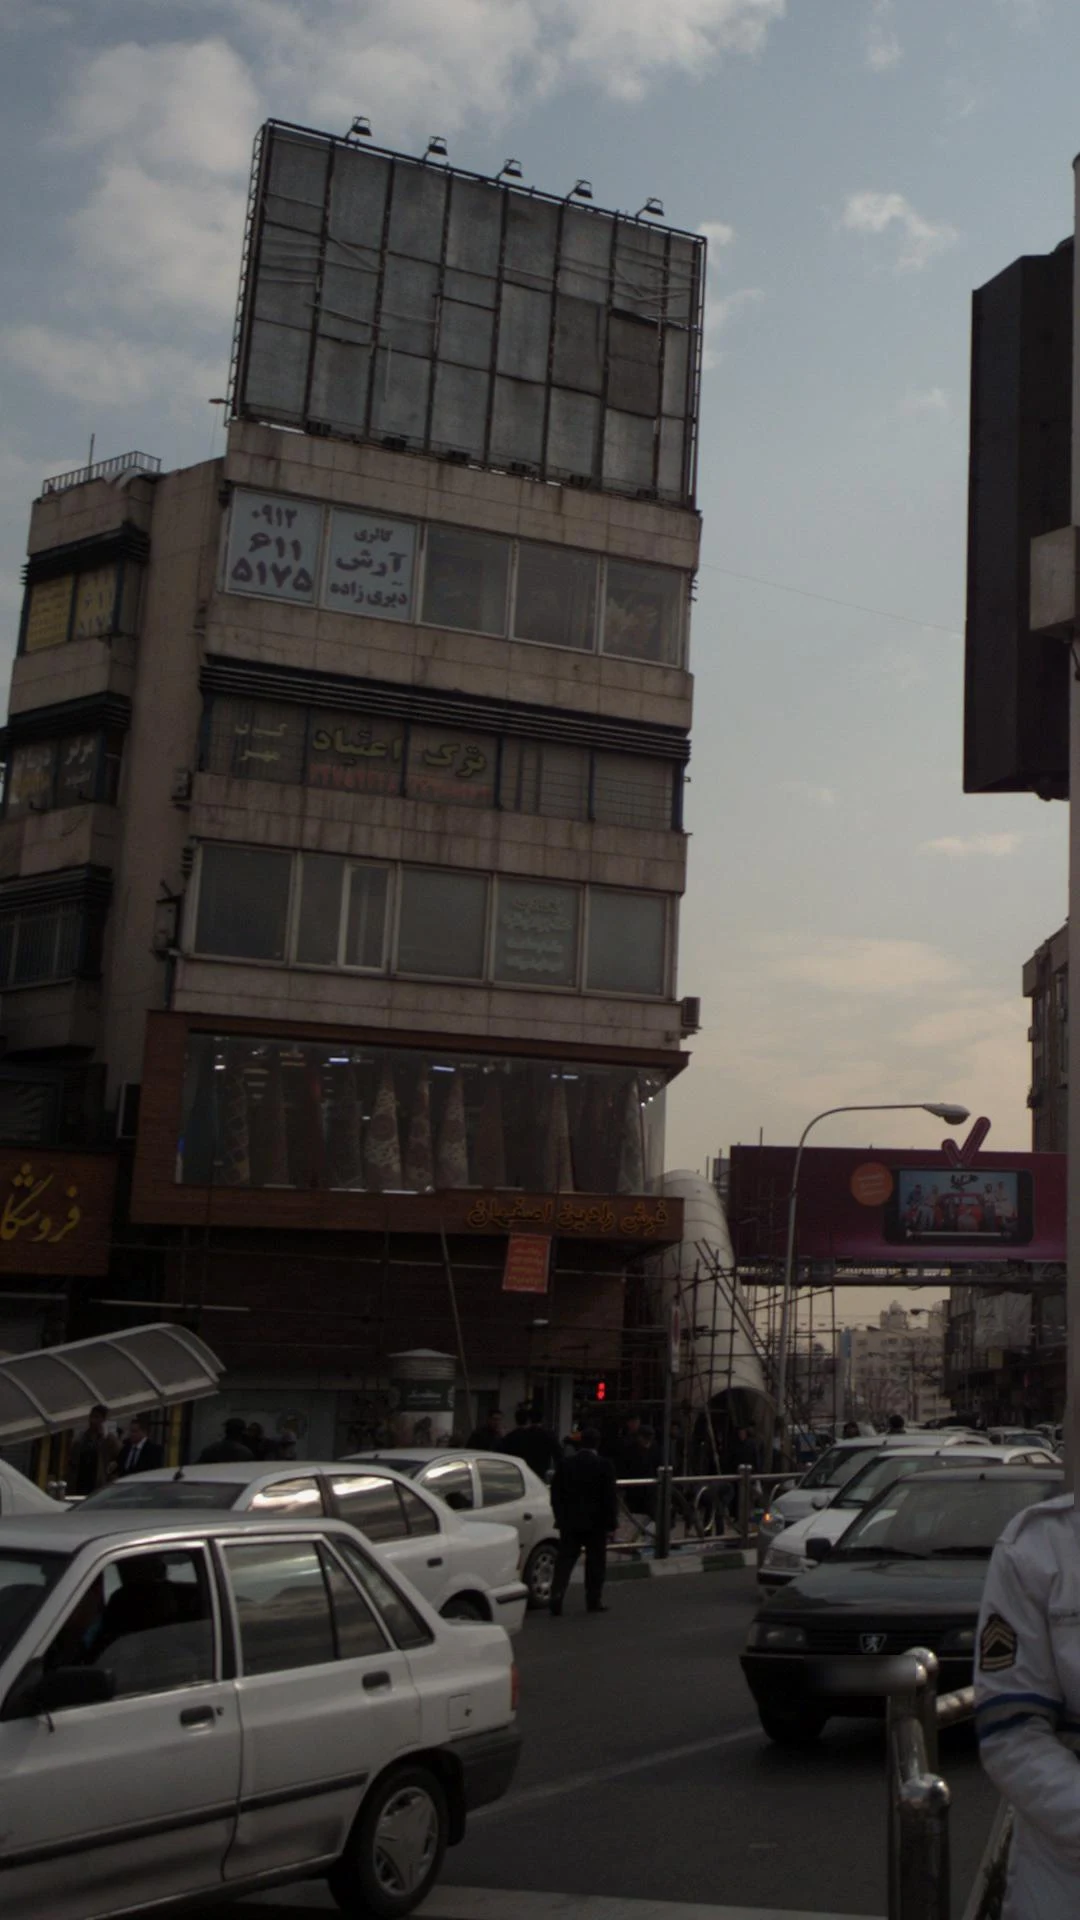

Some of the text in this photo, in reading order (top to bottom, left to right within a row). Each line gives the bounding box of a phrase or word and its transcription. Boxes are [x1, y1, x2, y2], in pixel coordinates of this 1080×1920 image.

[248, 532, 301, 561] ۶۱۱
[335, 548, 408, 577] آرش
[232, 557, 312, 592] ۵۱۷۵
[311, 727, 402, 766] اعتیاد
[424, 744, 487, 778] ترک
[0, 1161, 81, 1243] فروشگا
[620, 1200, 669, 1236] فرش
